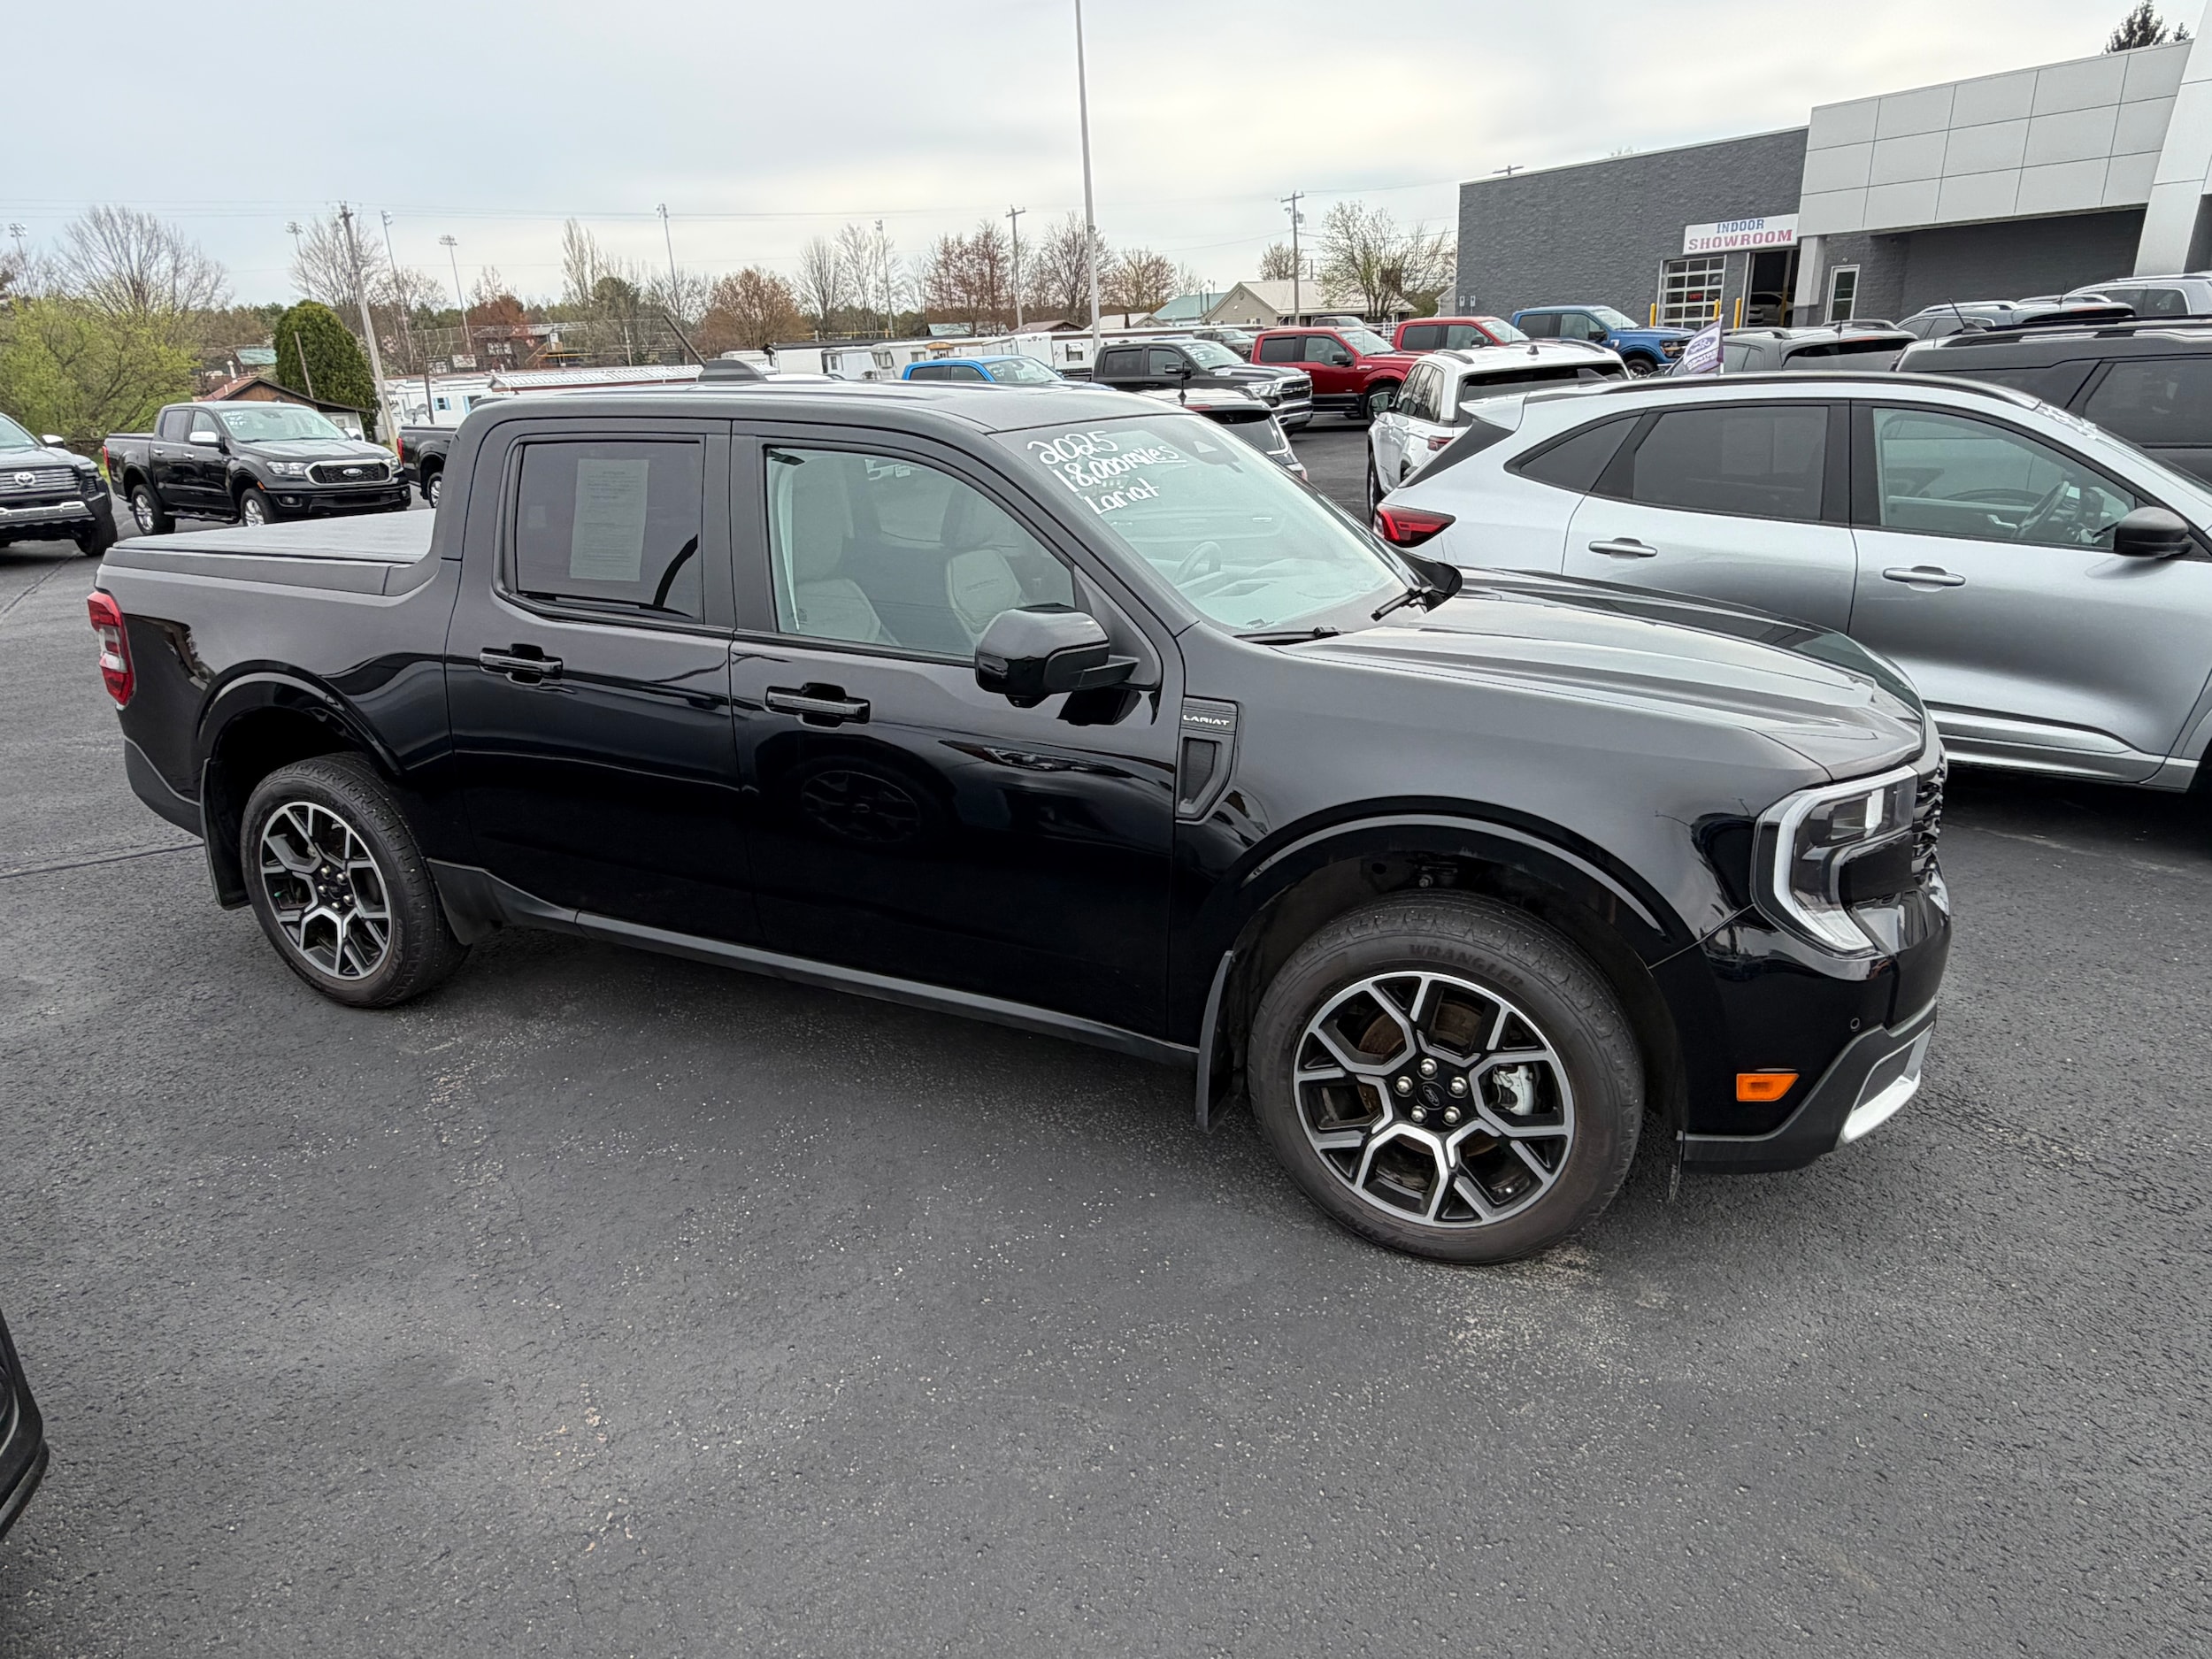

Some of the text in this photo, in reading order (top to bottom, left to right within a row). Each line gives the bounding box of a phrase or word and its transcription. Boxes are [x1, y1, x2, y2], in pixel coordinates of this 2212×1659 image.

[1688, 229, 1793, 250] SHOWROOM
[1717, 219, 1764, 234] INDOOR
[1026, 430, 1118, 465] 2025
[1083, 478, 1160, 515] Lariat
[1183, 714, 1229, 726] LARIAT
[1409, 943, 1524, 987] WRANGLER
